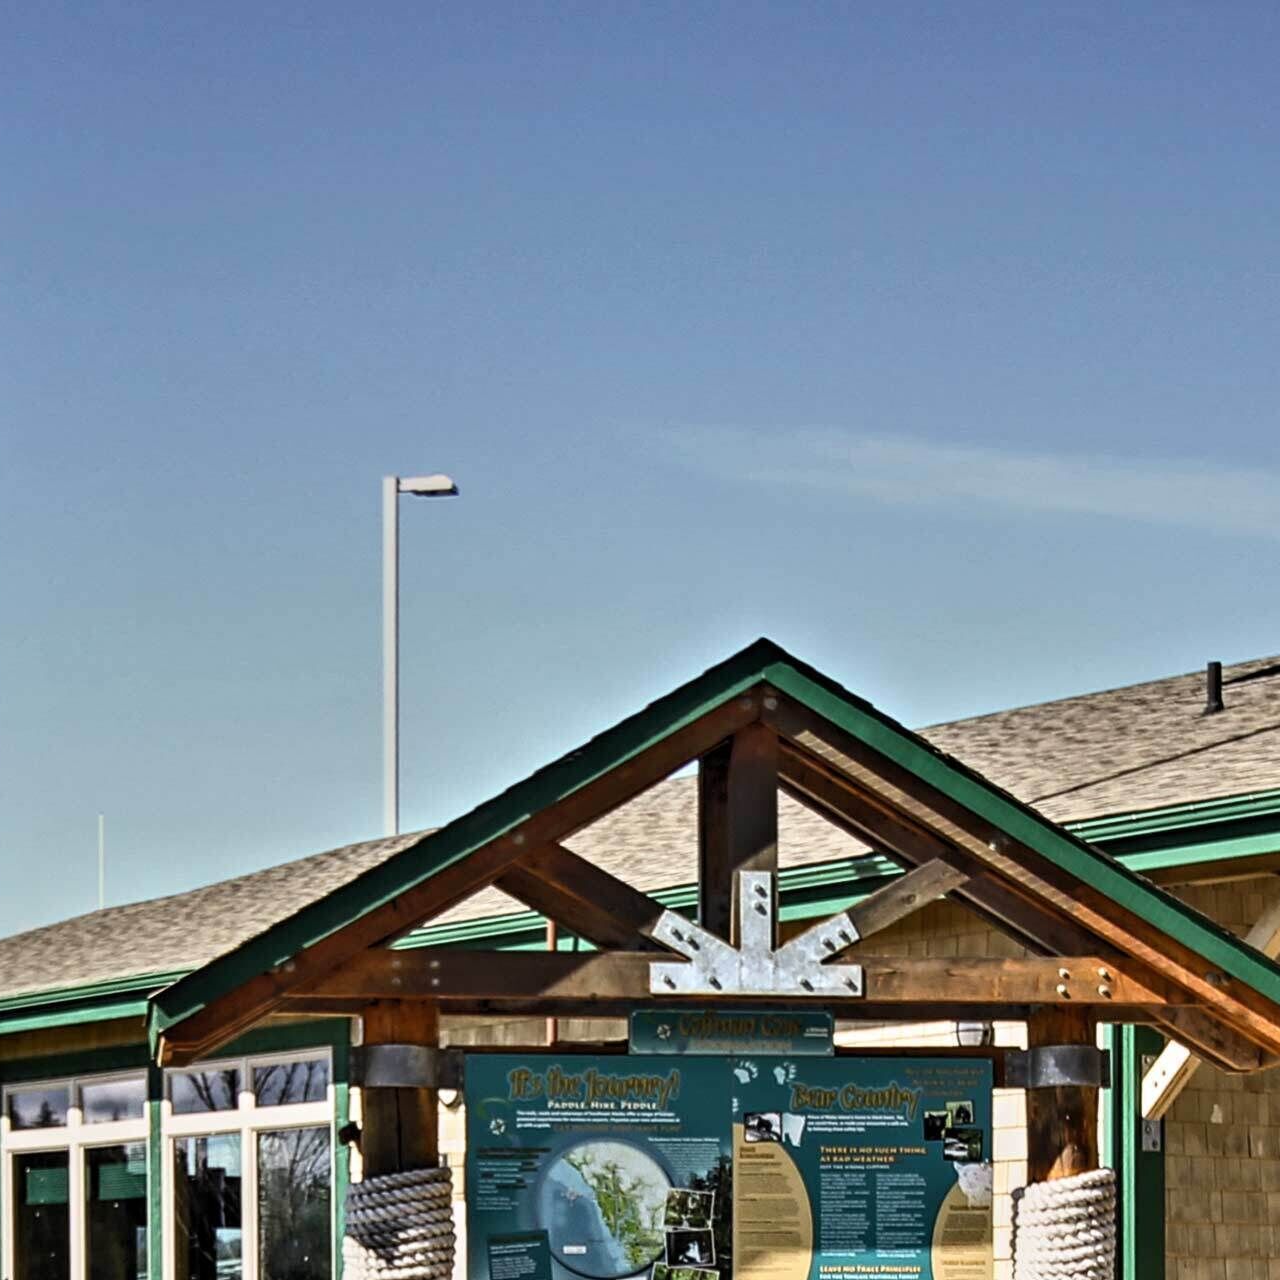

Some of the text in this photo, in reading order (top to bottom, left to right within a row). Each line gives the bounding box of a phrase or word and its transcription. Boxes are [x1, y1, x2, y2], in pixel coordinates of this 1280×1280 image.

[509, 1065, 680, 1110] It's the Journey!
[790, 1083, 837, 1110] Bear
[839, 1081, 920, 1120] Country
